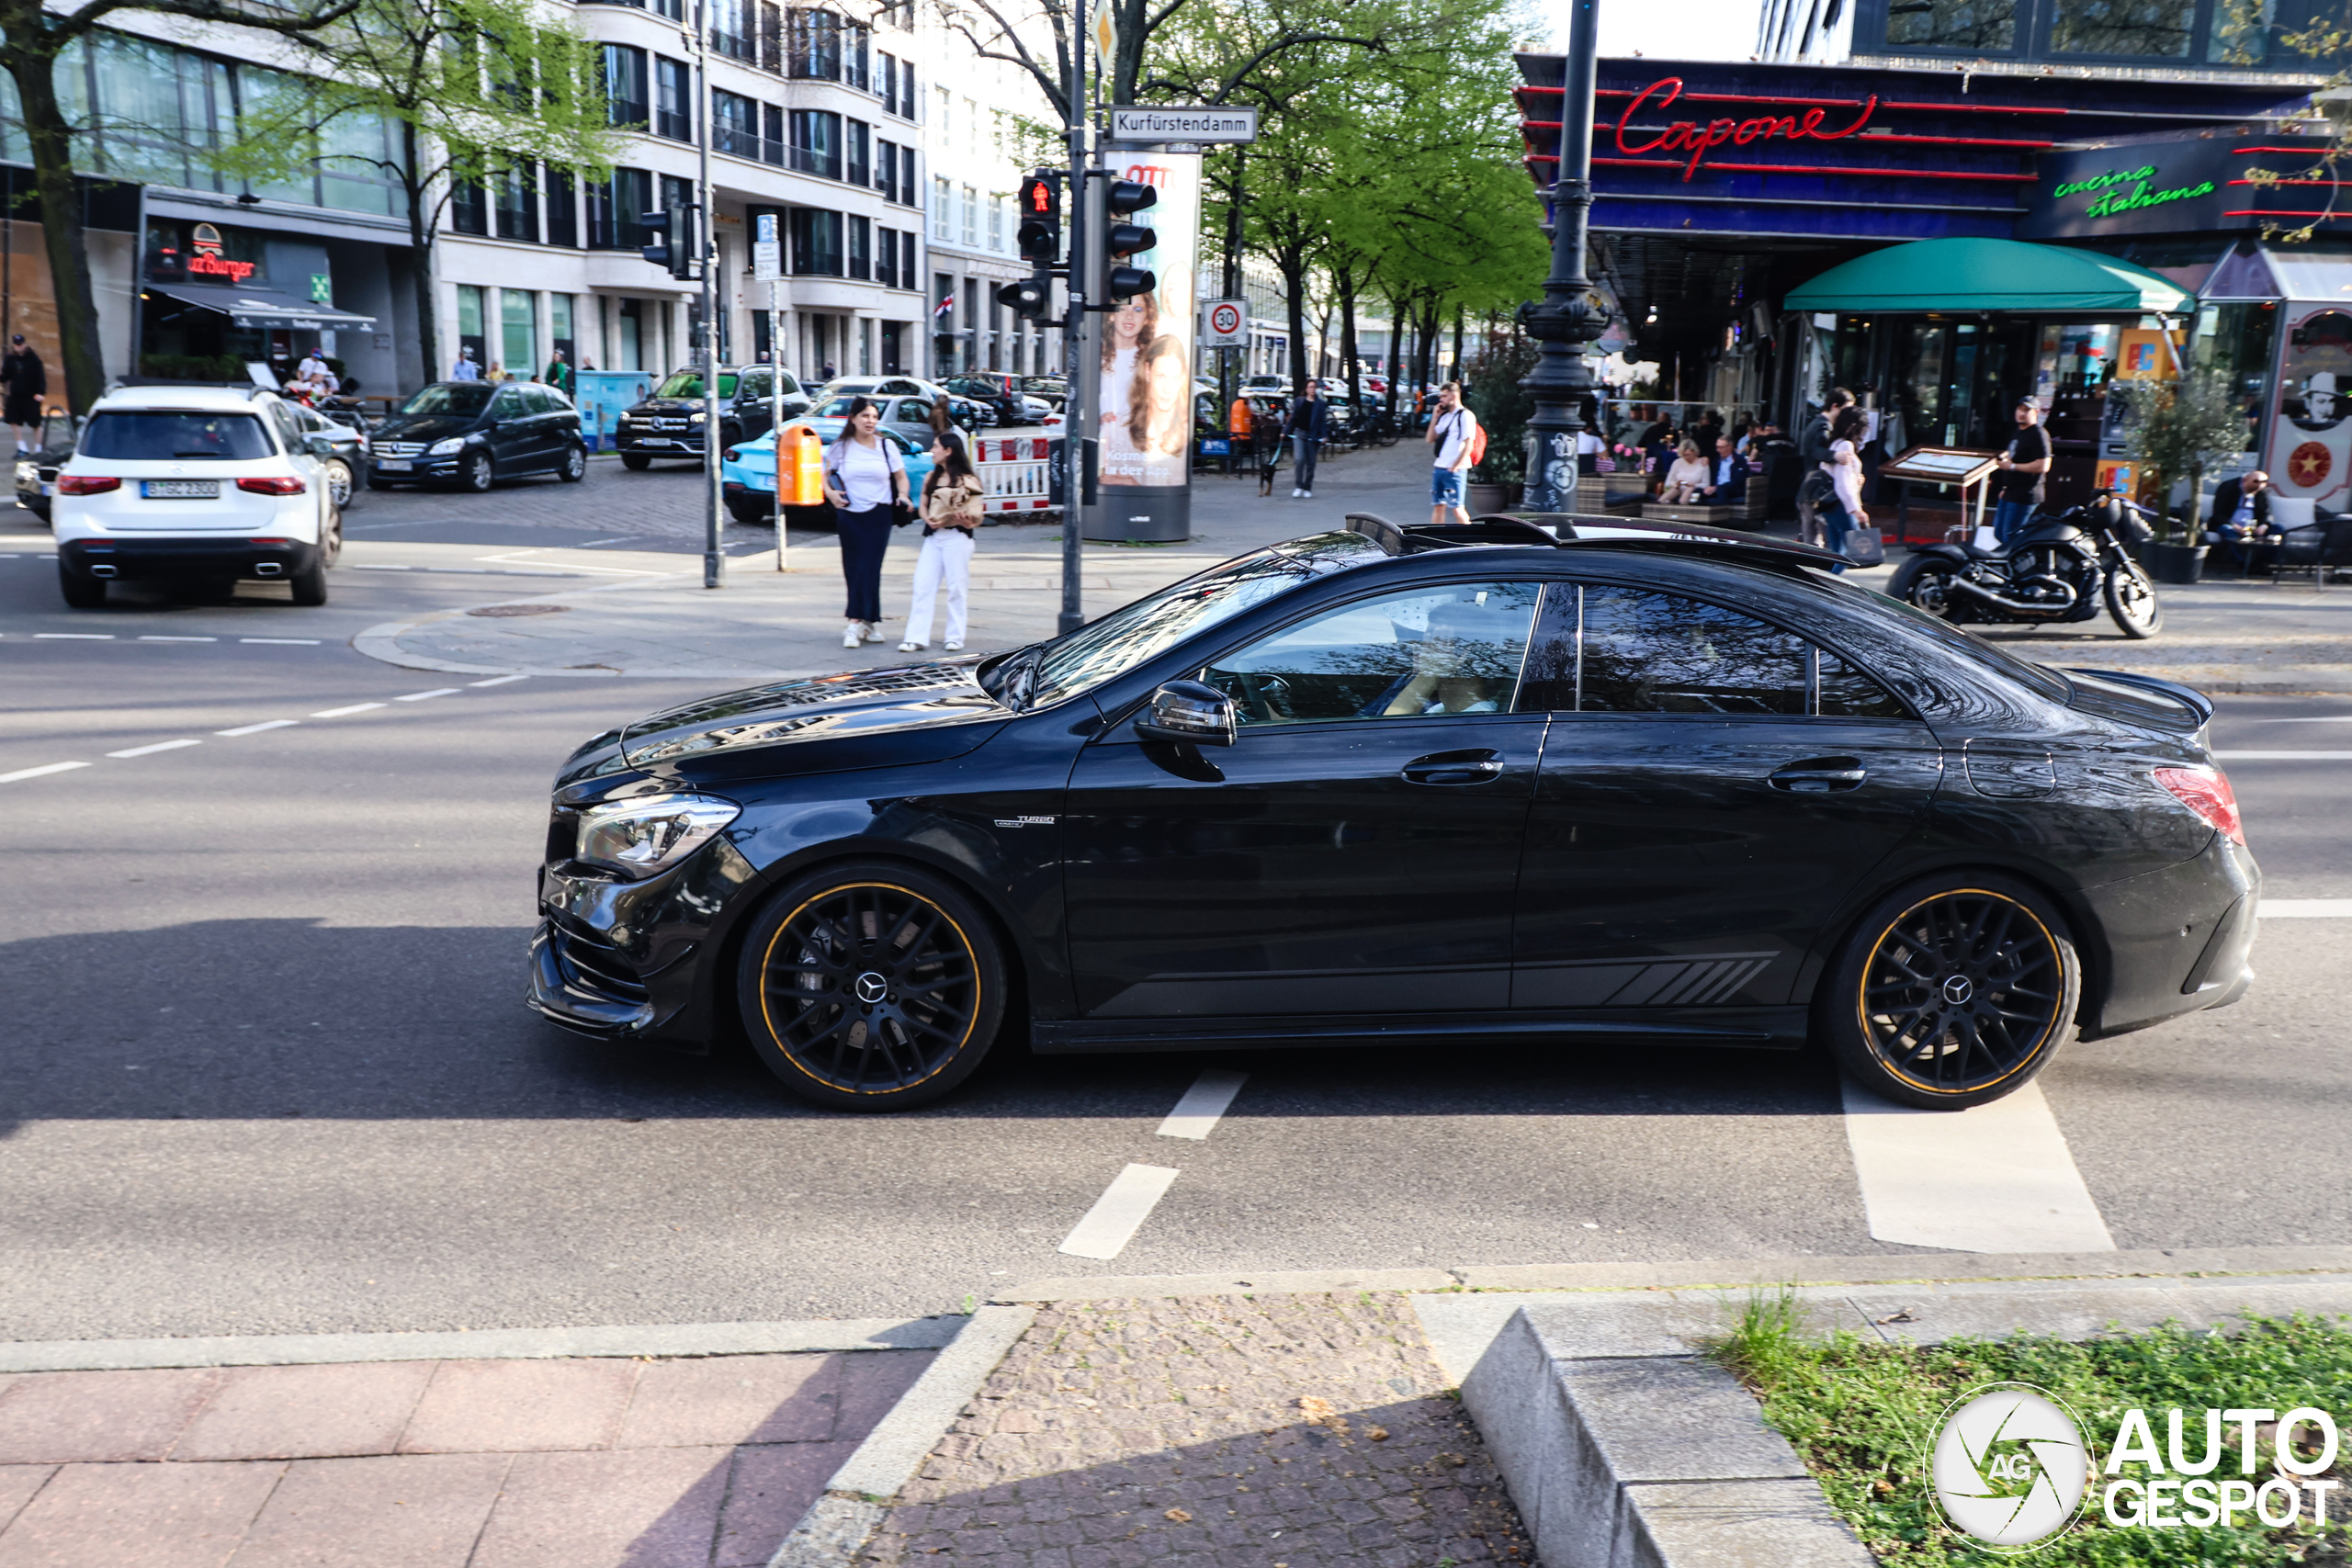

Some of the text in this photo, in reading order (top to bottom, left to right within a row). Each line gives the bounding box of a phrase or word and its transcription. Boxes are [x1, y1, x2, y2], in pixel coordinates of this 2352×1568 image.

[1118, 114, 1247, 131] Kurfürstendamm
[1616, 76, 1877, 183] Capone
[2054, 165, 2157, 197] cucina
[2086, 180, 2216, 218] italiana
[1217, 311, 1234, 326] 30
[1216, 335, 1238, 344] ZONE
[1119, 463, 1145, 476] der
[1146, 465, 1172, 478] App.
[1017, 815, 1055, 823] TURBO
